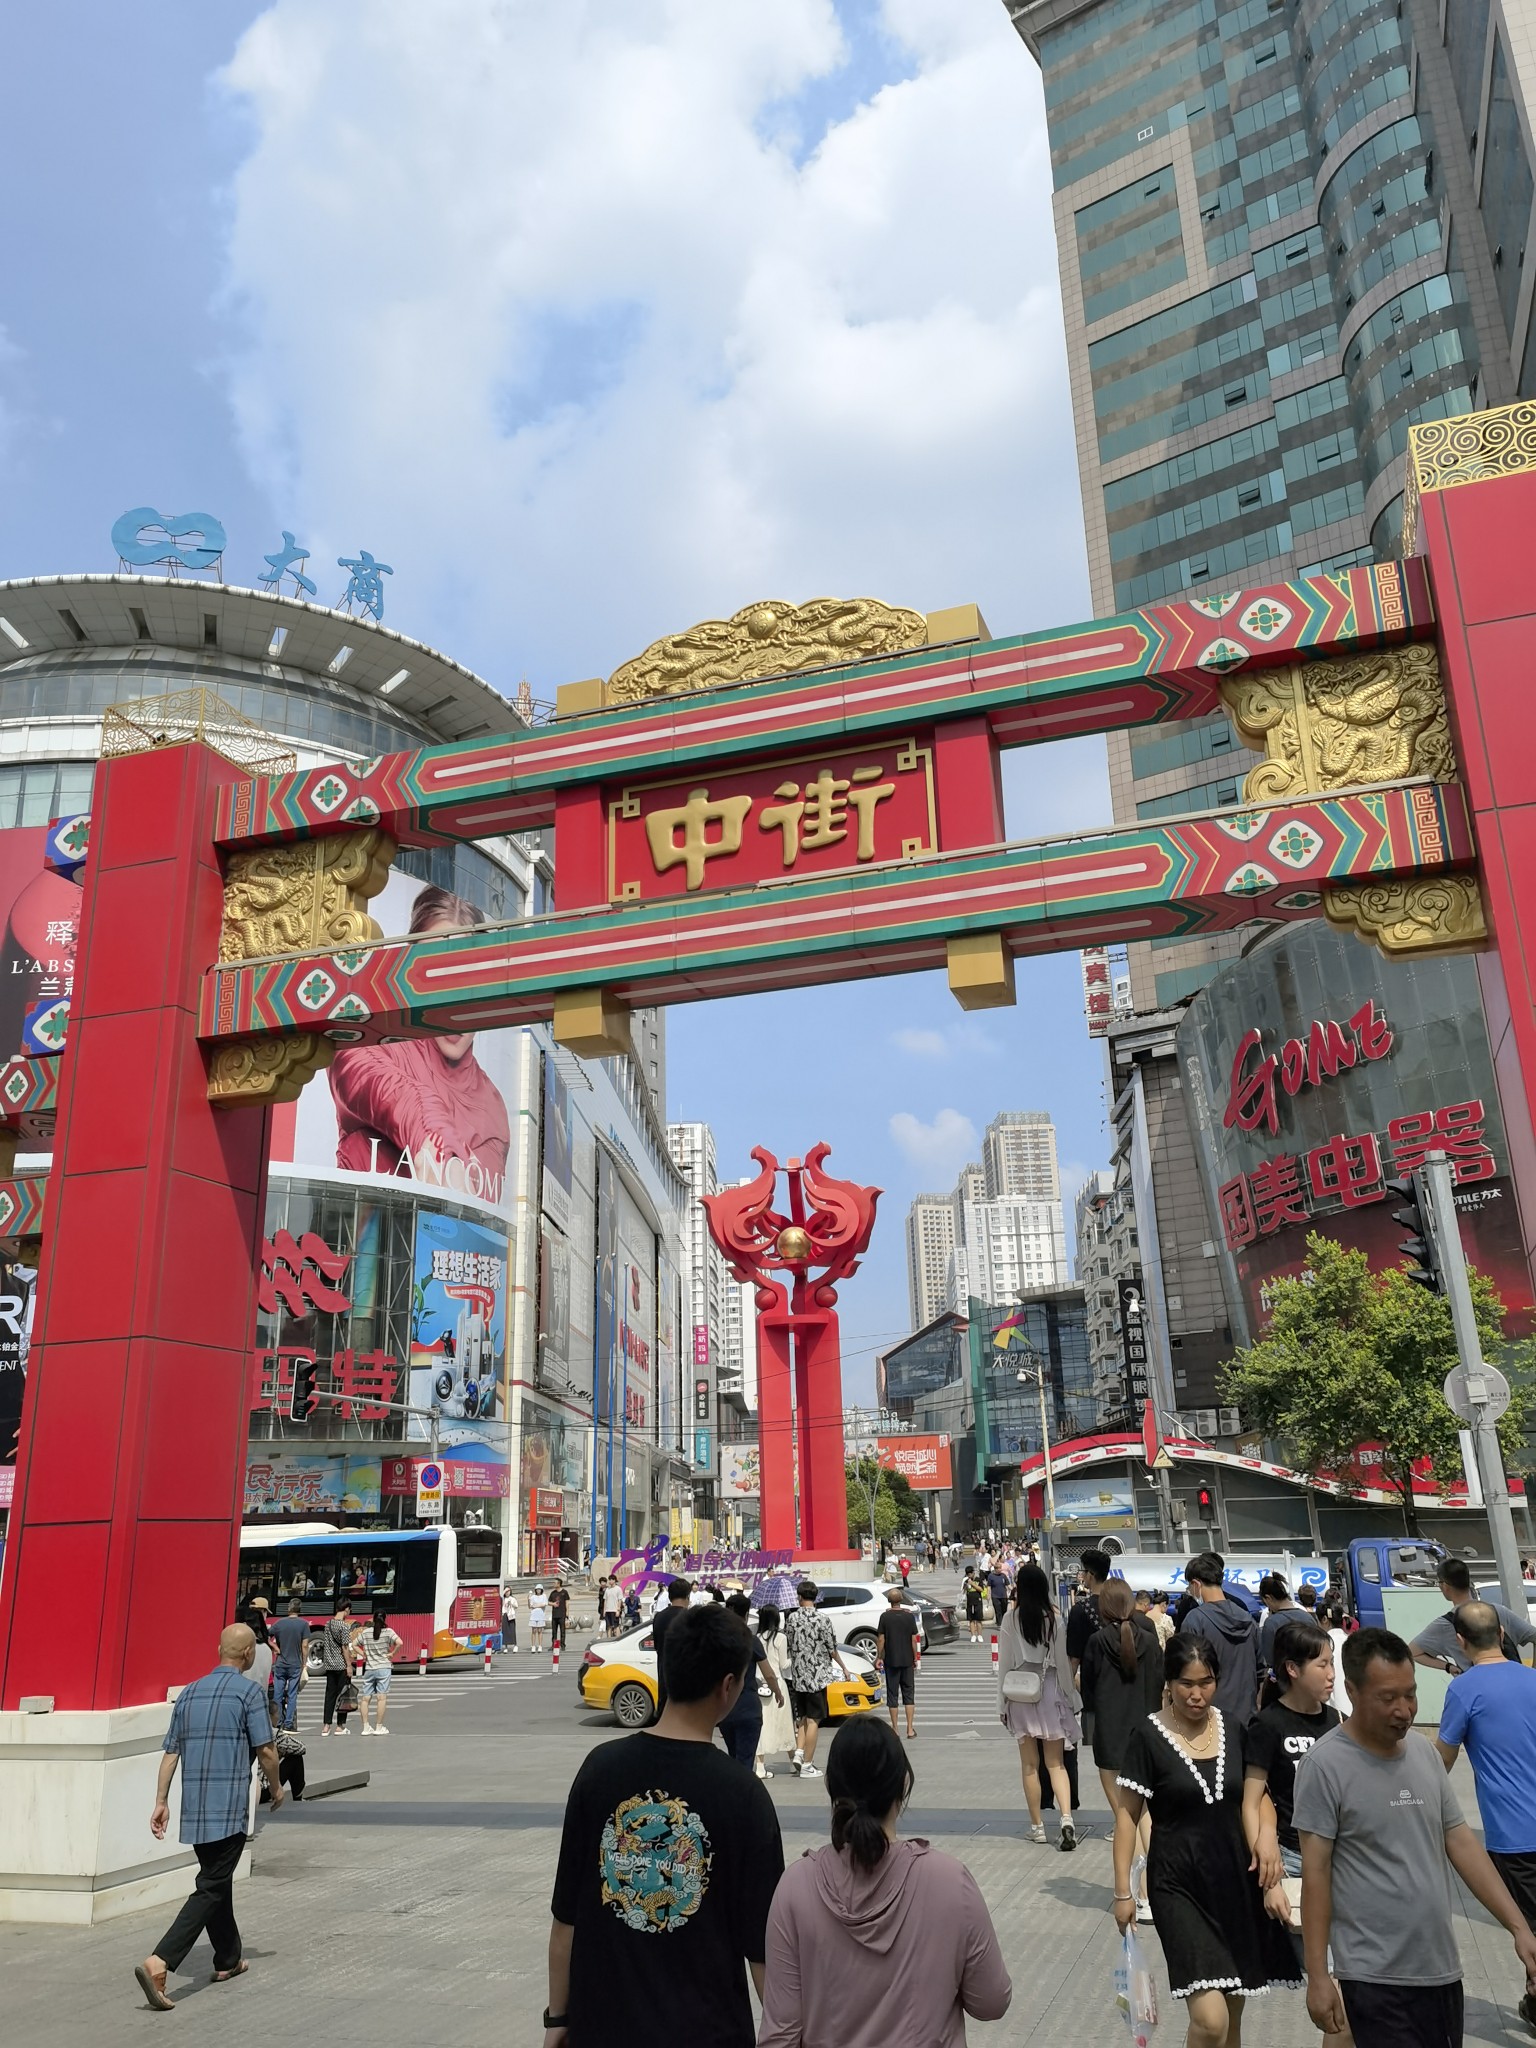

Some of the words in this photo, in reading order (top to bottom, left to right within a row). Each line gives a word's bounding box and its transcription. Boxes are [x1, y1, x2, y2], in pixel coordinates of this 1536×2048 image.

[257, 530, 394, 621] 大商
[645, 766, 896, 891] 中街
[45, 921, 73, 945] 释
[1218, 1099, 1497, 1251] 国美电器
[1480, 1188, 1503, 1201] 方太
[432, 1249, 502, 1290] 理想生活家
[992, 1352, 1034, 1368] 大悦城
[1389, 1799, 1425, 1807] BALENCIAGA
[607, 1851, 629, 1863] WELL
[632, 1855, 653, 1868] DONE
[654, 1858, 672, 1871] YOU
[672, 1863, 686, 1874] DID
